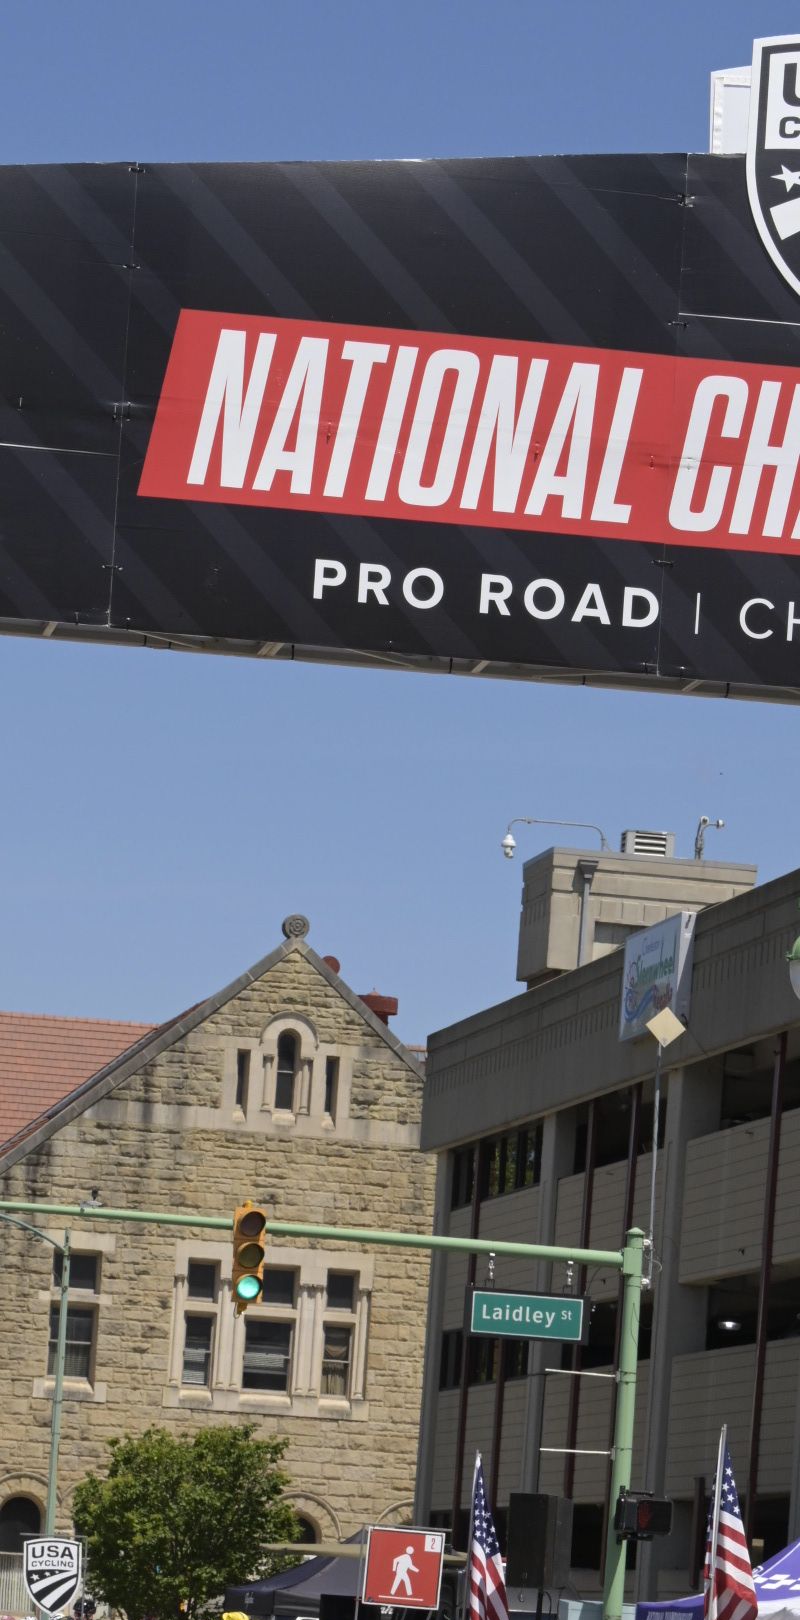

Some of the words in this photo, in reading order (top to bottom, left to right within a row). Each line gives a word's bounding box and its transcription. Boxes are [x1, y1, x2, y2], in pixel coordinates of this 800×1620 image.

[187, 328, 644, 525] NATIONAL
[668, 374, 800, 541] CH
[312, 557, 445, 609] PRO
[478, 573, 661, 628] ROAD
[481, 1303, 556, 1329] Laidley
[560, 1309, 573, 1321] St
[31, 1545, 74, 1561] USA
[430, 1537, 437, 1551] 2
[31, 1559, 74, 1568] CYCLING
